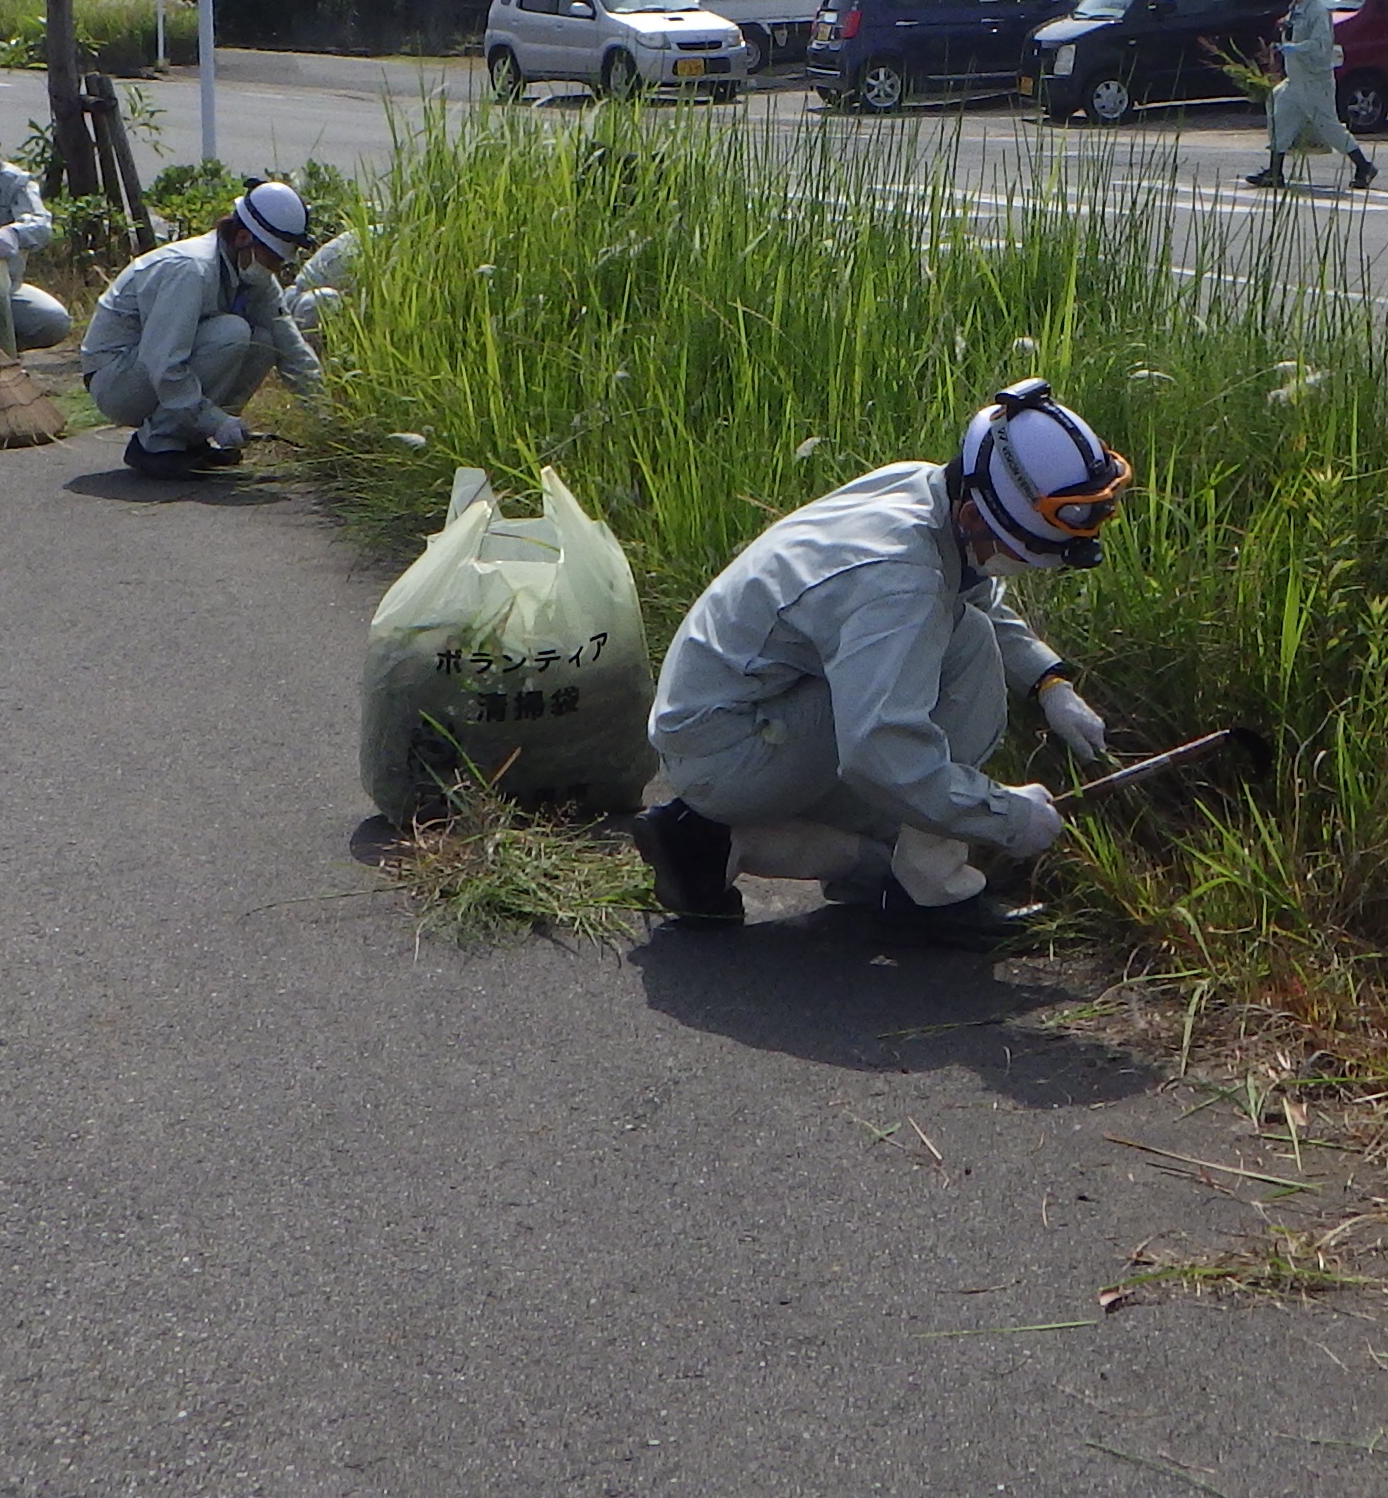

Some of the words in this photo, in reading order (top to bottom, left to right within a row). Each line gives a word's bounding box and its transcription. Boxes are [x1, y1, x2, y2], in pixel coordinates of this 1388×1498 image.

[435, 631, 609, 676] ボランティア
[476, 685, 581, 723] 清掃袋
